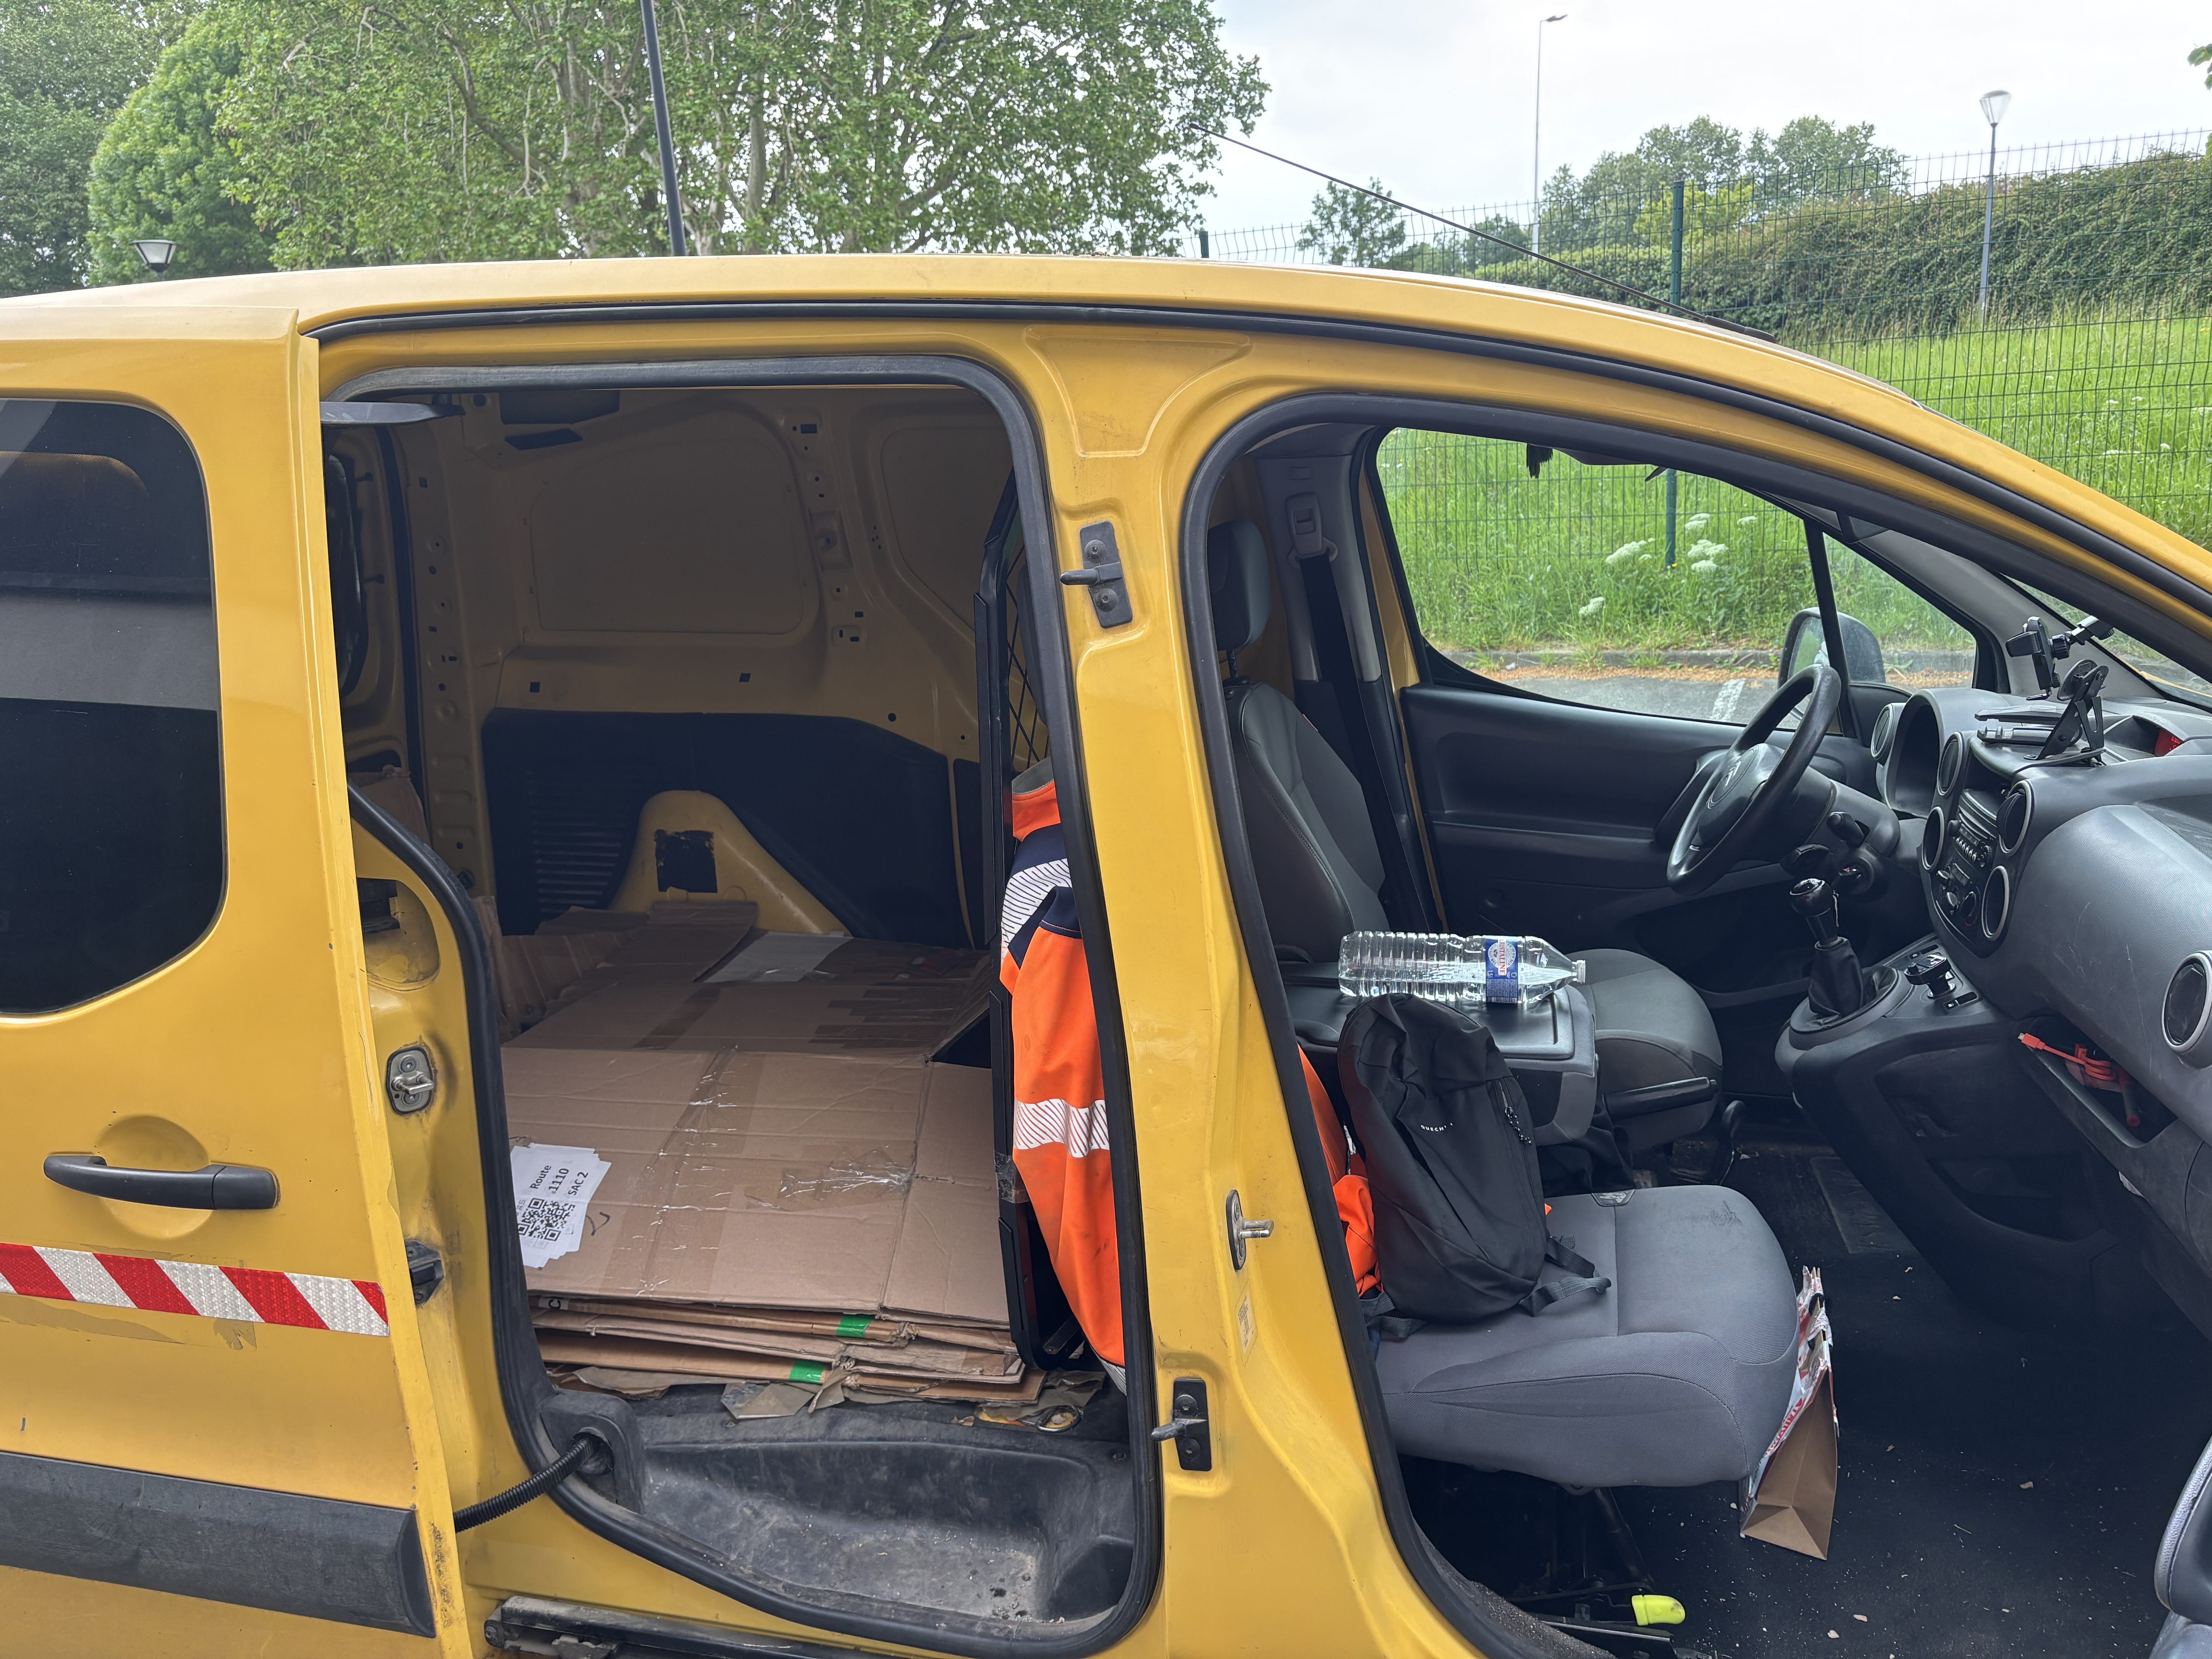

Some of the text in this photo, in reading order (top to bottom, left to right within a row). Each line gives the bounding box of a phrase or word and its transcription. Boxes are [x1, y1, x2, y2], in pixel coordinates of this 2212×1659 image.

[1420, 1122, 1453, 1132] QUECH
[530, 1165, 552, 1189] Route
[568, 1179, 584, 1196] SAC
